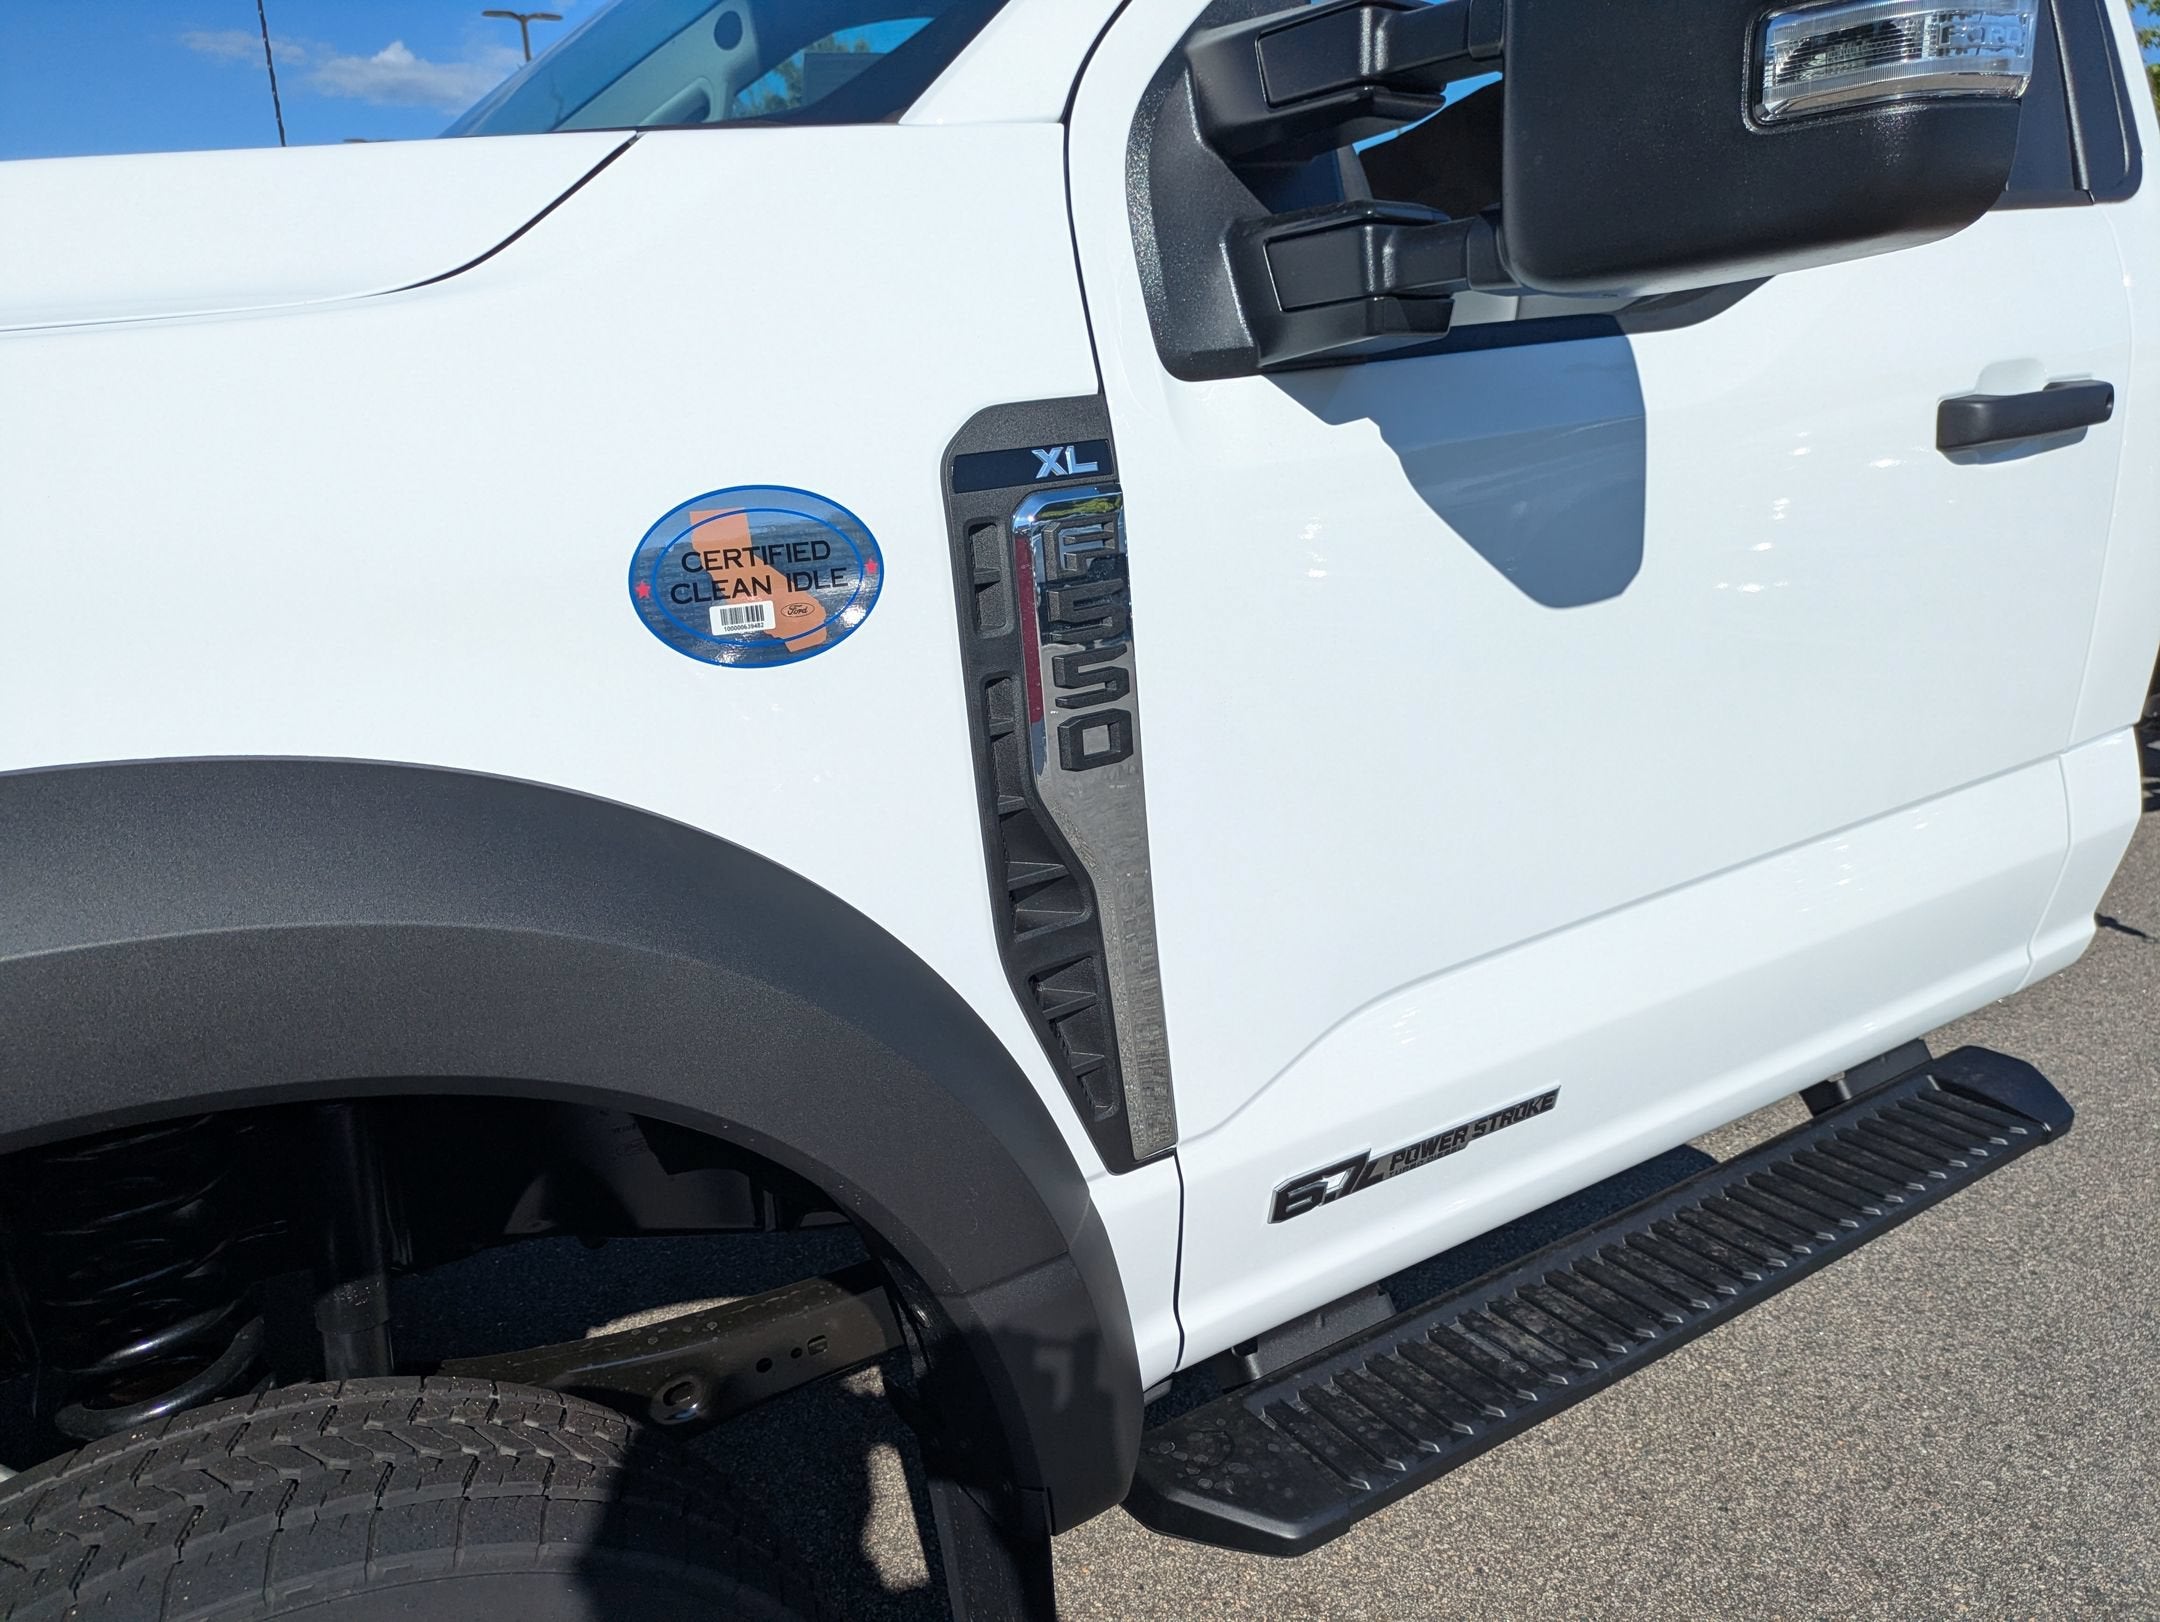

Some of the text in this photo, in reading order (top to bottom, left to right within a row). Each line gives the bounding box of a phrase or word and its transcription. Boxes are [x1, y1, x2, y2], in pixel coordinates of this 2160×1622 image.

[1032, 445, 1099, 479] XL
[682, 540, 831, 573] CERTIFIED
[670, 567, 848, 605] CLEAN IDLE
[786, 604, 810, 616] Ford
[1389, 1125, 1470, 1171] POWER
[1472, 1092, 1556, 1139] STROKE
